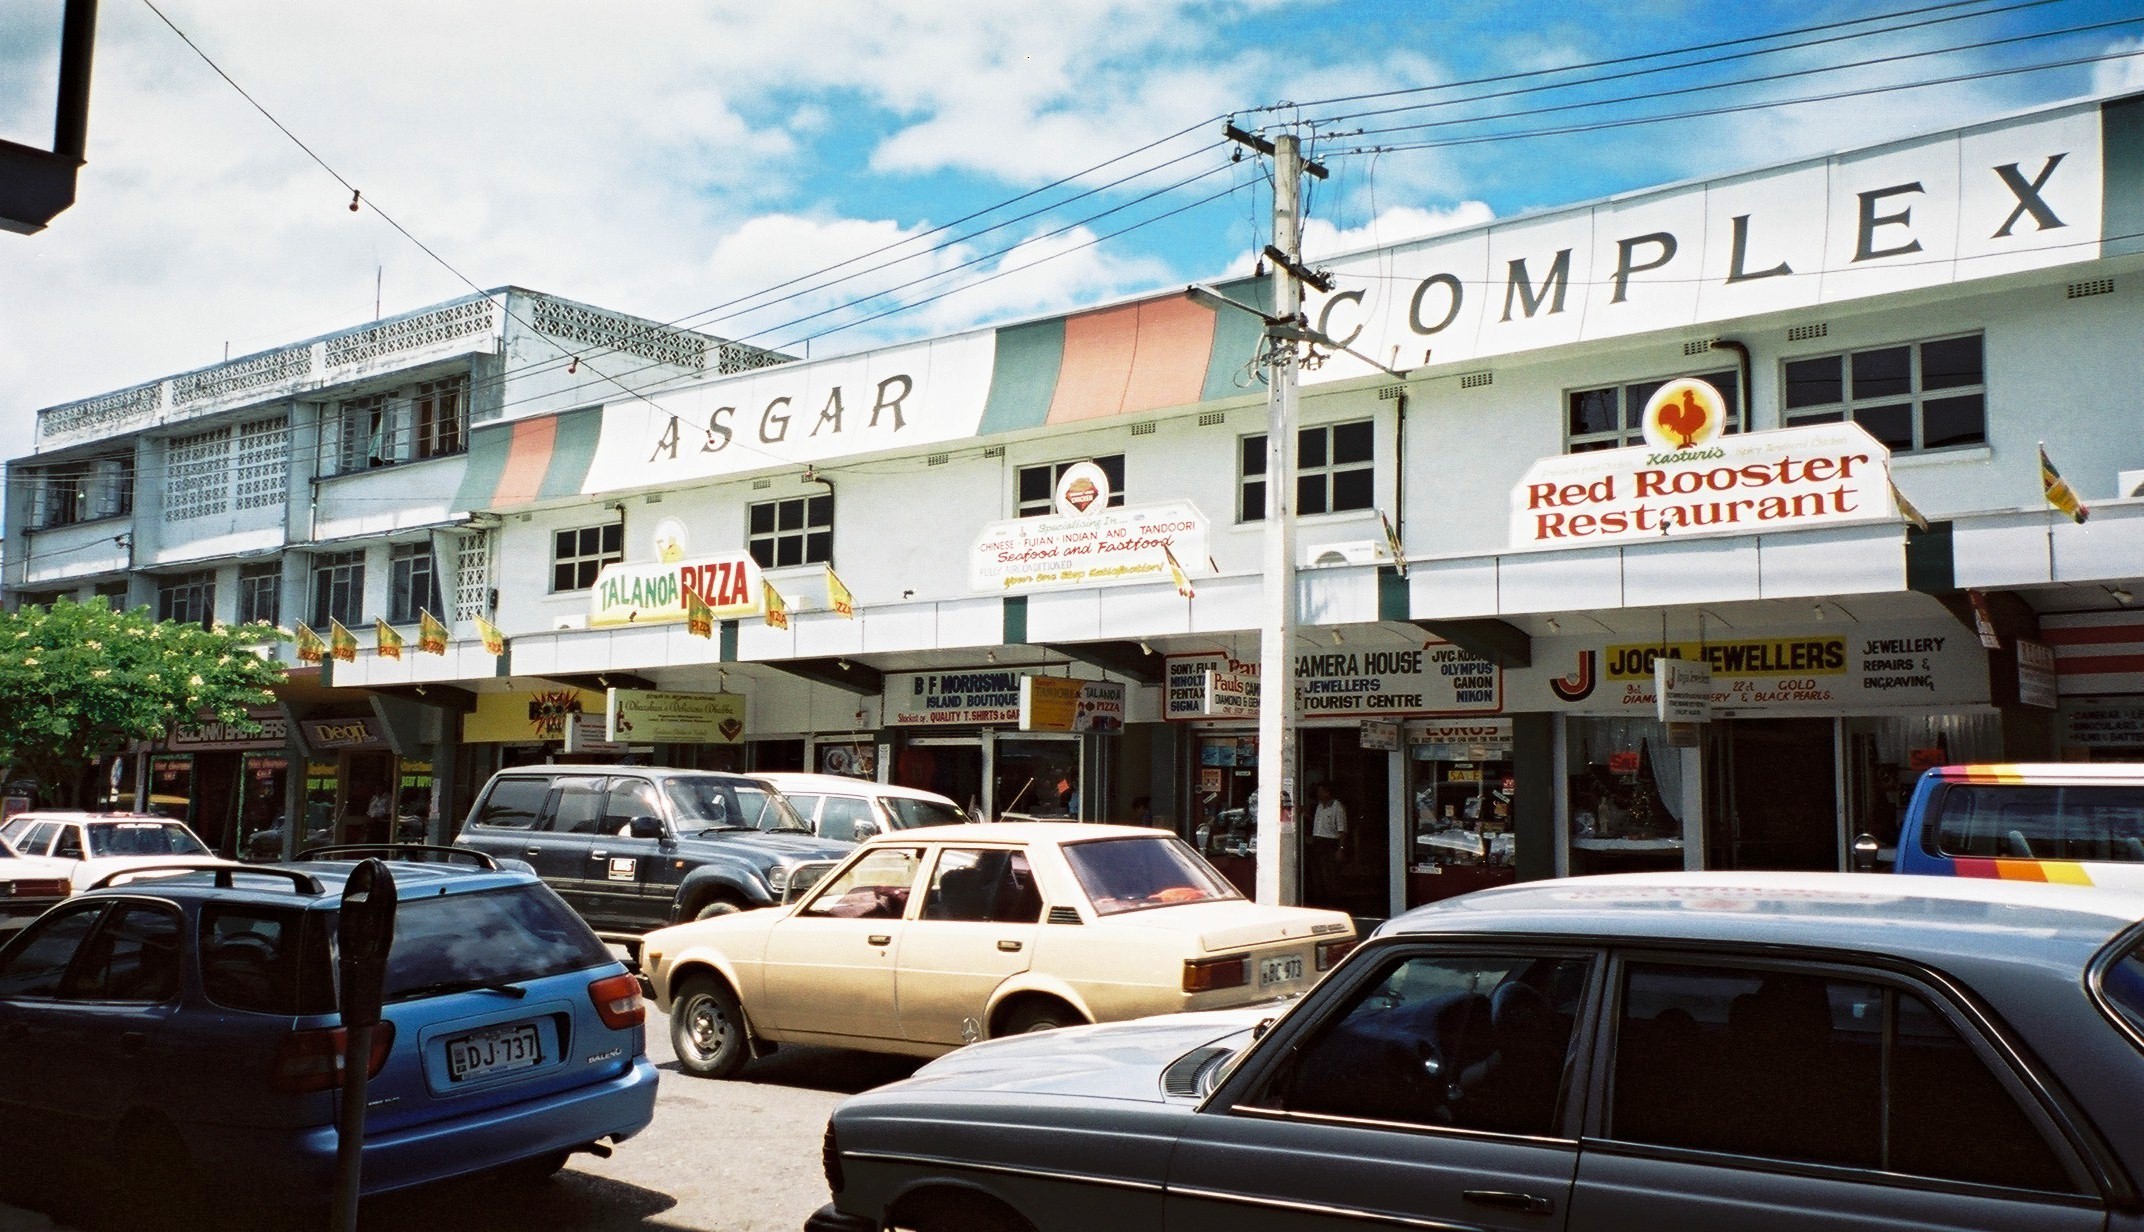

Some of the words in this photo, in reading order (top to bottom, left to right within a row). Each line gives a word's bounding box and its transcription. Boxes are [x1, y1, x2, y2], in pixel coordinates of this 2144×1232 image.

[649, 374, 913, 462] ASGAR
[1317, 152, 2070, 348] COMPLEX
[1527, 475, 1616, 510] Red
[1633, 454, 1869, 501] Rooster
[1535, 485, 1859, 540] Restaurant
[981, 540, 1014, 552] CHINESE
[1024, 536, 1054, 547] FIJIAN
[1062, 532, 1098, 543] INDIAN
[1106, 528, 1127, 538] AND
[1139, 521, 1195, 535] TANDOORI
[997, 550, 1059, 563] Seafood
[1063, 545, 1091, 557] and
[1098, 536, 1174, 553] Fastfood
[600, 571, 678, 612] TALANOA
[681, 560, 749, 609] PIZZA
[1863, 638, 1945, 655] JEWELLERY
[1365, 651, 1422, 676] HOUSE
[1441, 663, 1493, 675] OLYMPUS
[1864, 659, 1915, 671] REPAIRS
[914, 677, 924, 694] B
[929, 676, 937, 694] F
[1304, 679, 1381, 693] JEWELLERS
[1454, 676, 1492, 689] CANON
[1778, 679, 1816, 691] GOLD
[1864, 675, 1935, 691] ENGRAVING
[1085, 686, 1121, 700] TALANOA
[1456, 690, 1492, 702] NIKON
[1755, 692, 1790, 701] BLACK
[927, 696, 961, 708] ISLAND
[967, 693, 1018, 707] BOUTIQUE
[1096, 701, 1120, 712] PIZZA
[1170, 700, 1199, 711] SIGMA
[1303, 696, 1362, 709] TOURIST
[1367, 694, 1422, 707] CENTRE
[930, 711, 960, 723] QUALITY
[1449, 772, 1480, 781] SALE
